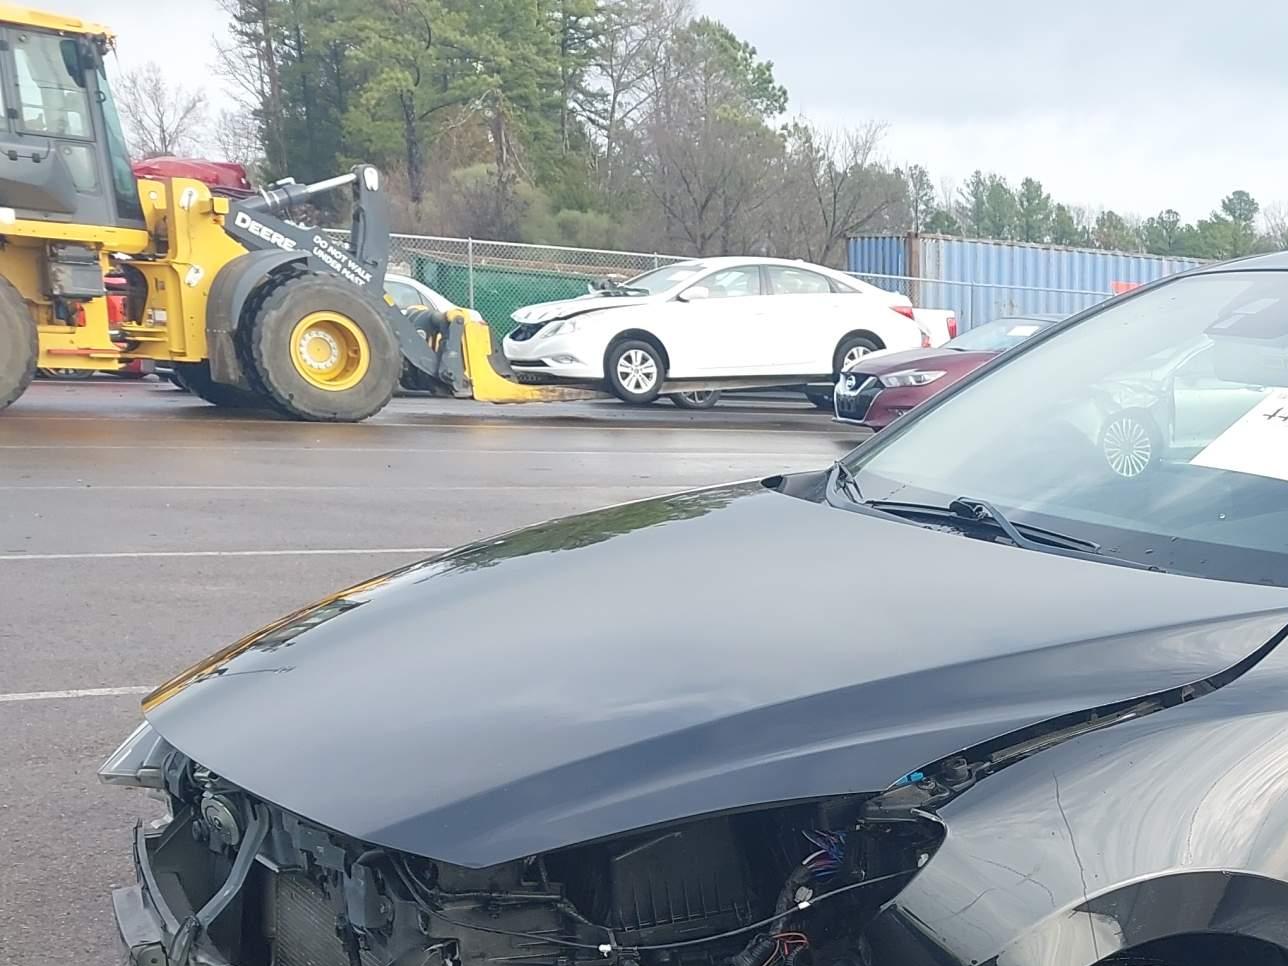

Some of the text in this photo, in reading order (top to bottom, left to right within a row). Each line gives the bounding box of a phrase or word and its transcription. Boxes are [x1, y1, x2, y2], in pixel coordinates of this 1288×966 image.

[235, 211, 297, 252] DEERE
[312, 246, 367, 287] UNDER MAST
[313, 235, 373, 282] DO NOT WALK
